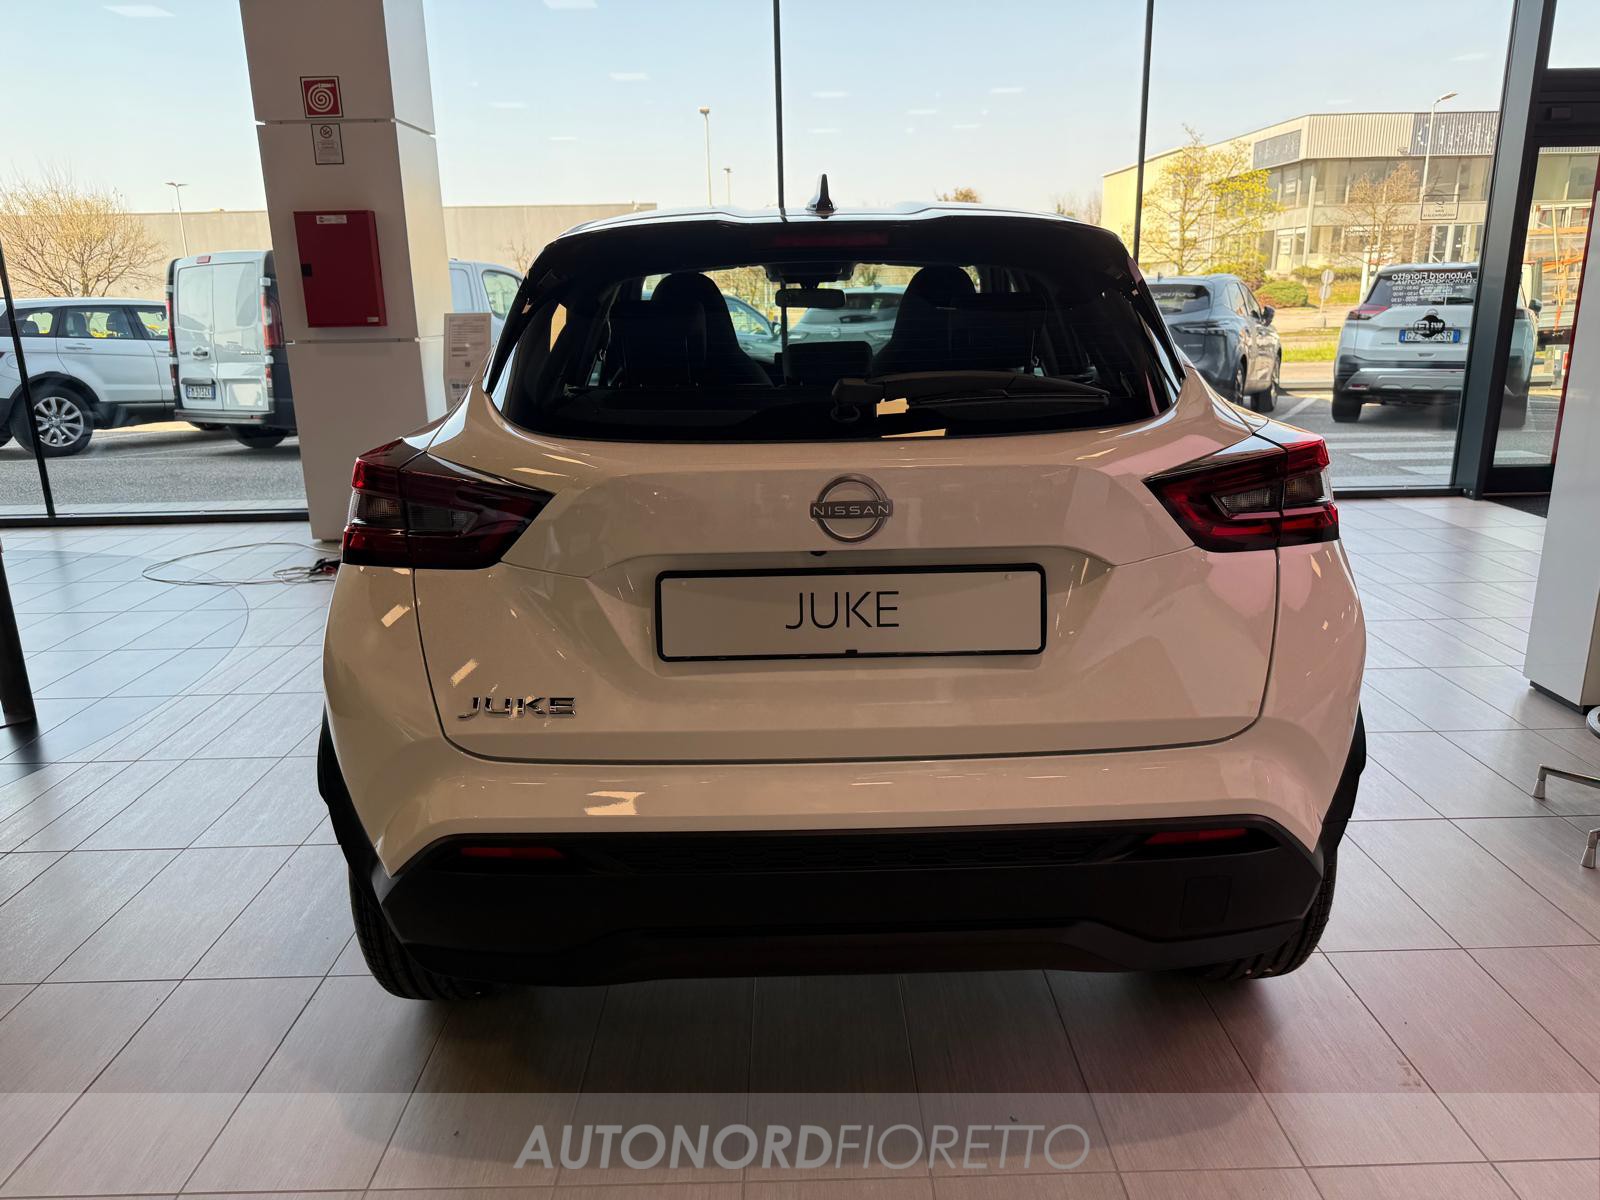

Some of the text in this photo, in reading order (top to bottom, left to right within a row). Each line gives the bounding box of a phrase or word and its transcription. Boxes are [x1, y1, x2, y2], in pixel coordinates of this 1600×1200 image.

[813, 504, 889, 516] NISSAN
[786, 591, 899, 629] JUKE
[457, 697, 576, 720] JUKE
